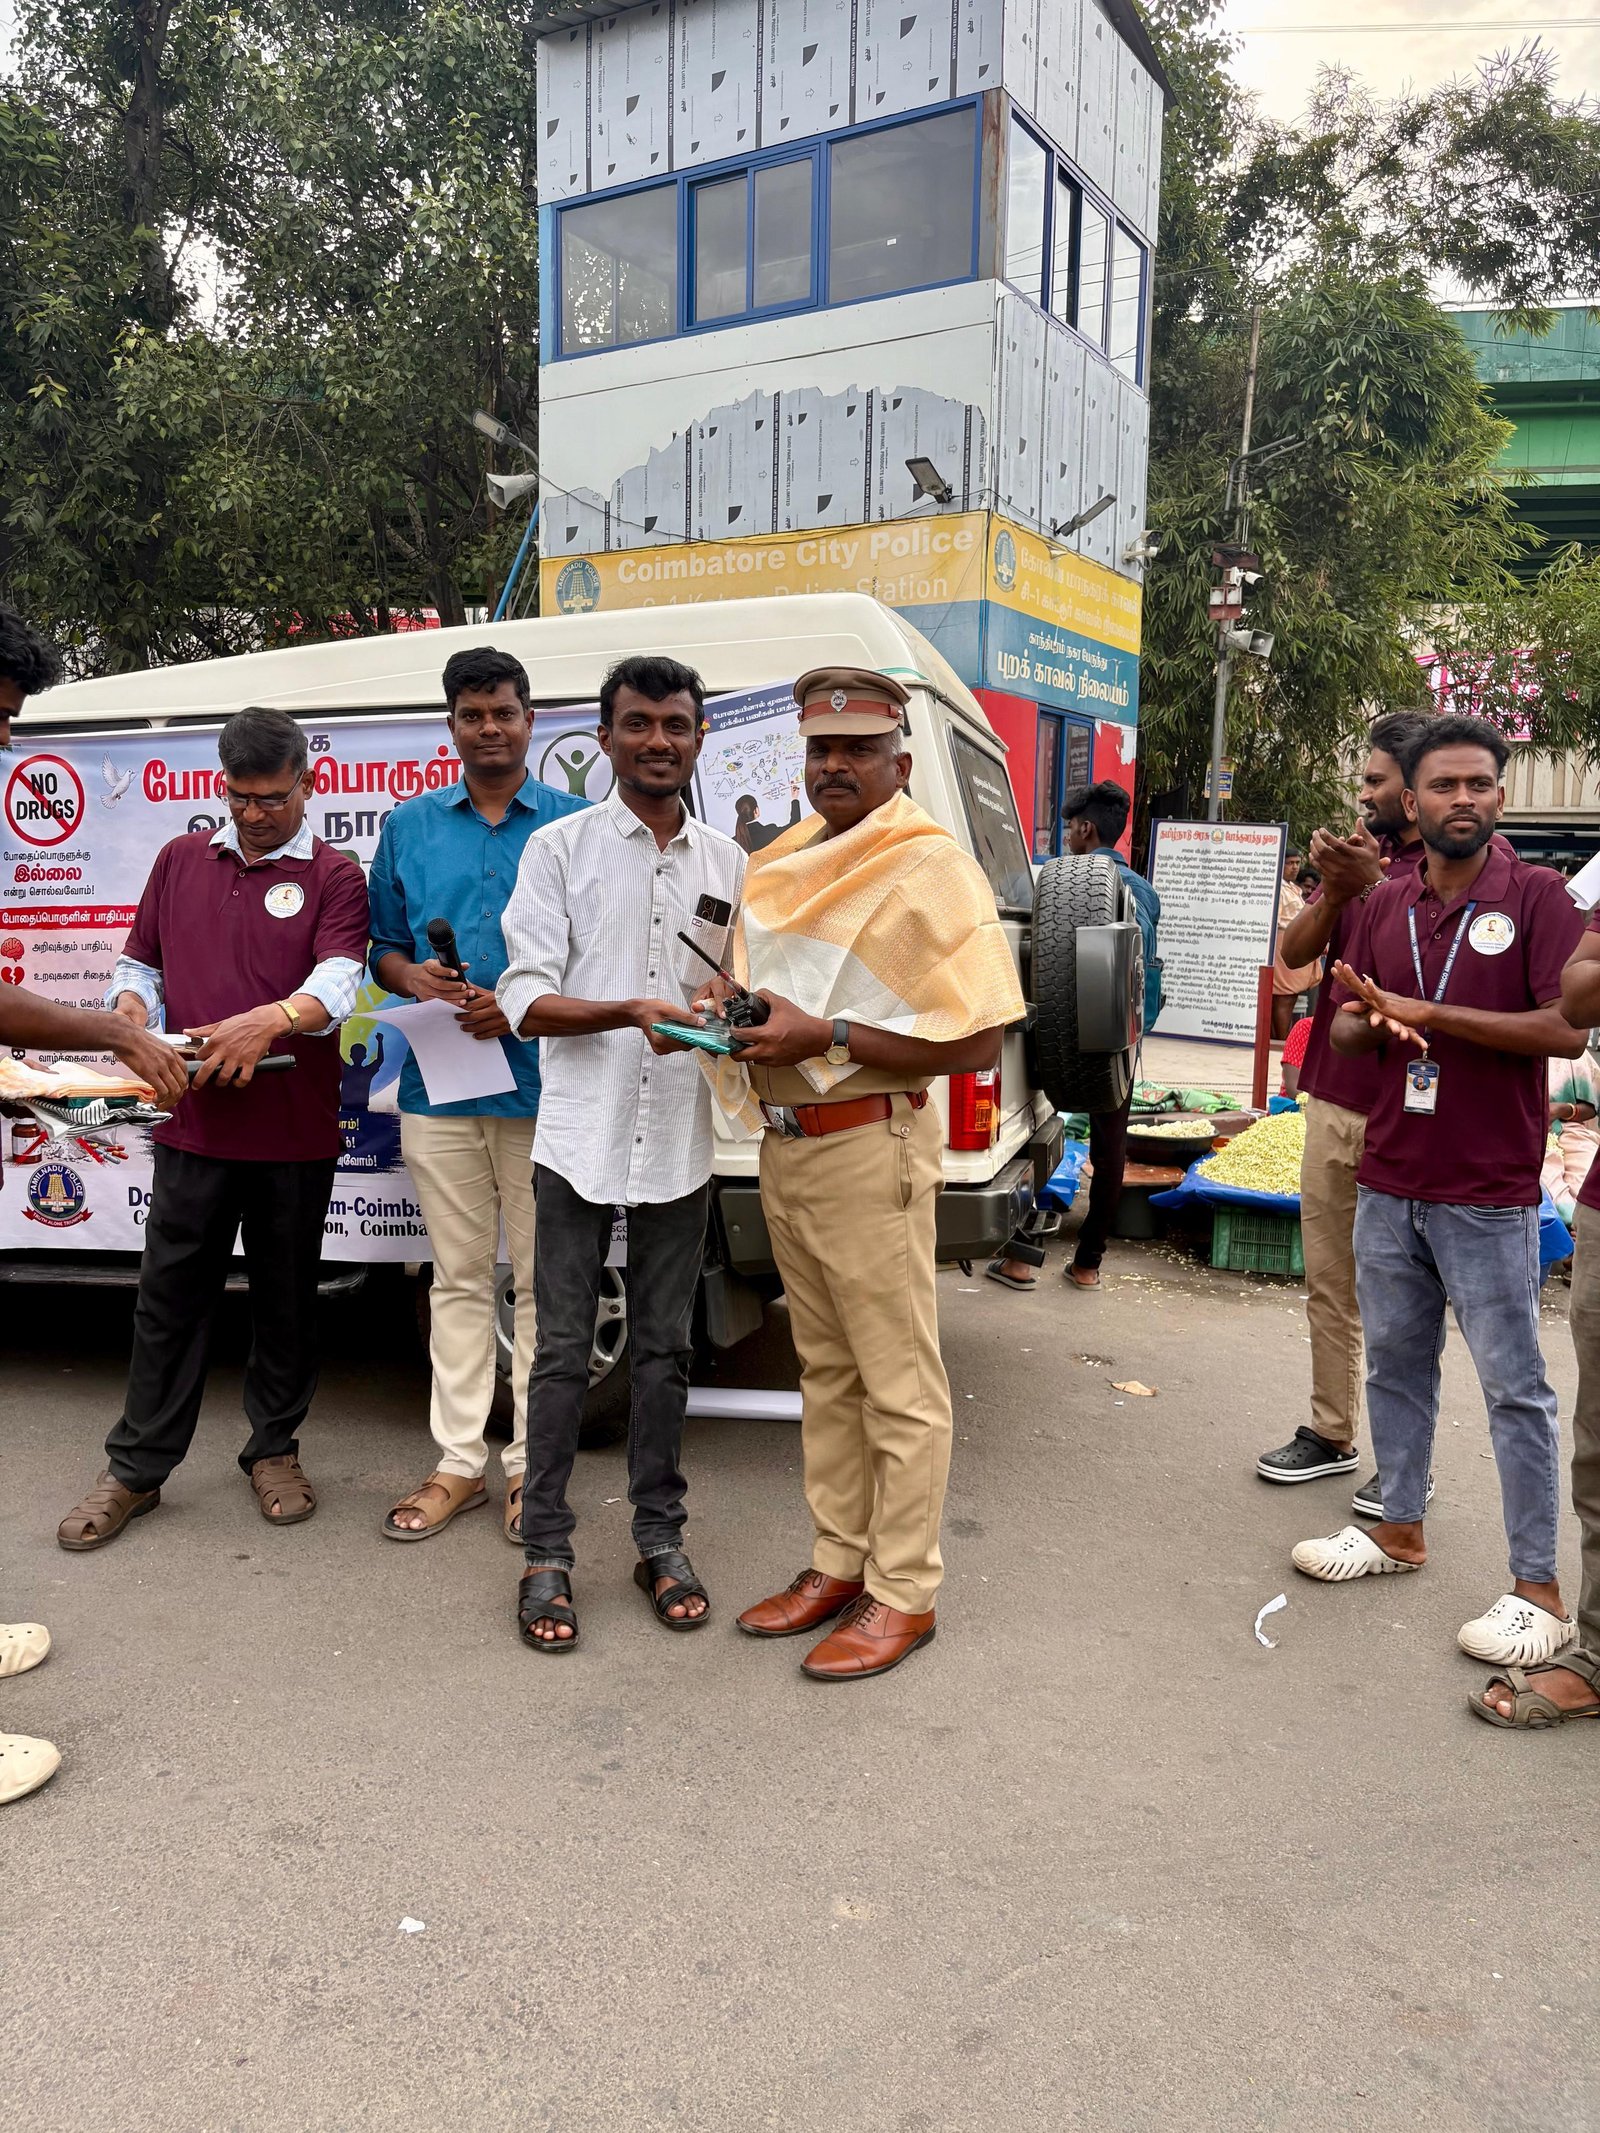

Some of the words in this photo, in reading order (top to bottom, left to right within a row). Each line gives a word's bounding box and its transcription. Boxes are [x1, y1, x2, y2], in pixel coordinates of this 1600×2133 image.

[618, 548, 785, 584] Coimbatore
[797, 538, 858, 571] City
[870, 525, 974, 560] Police
[558, 562, 583, 590] TAMILNADU
[584, 563, 600, 588] POLICE
[857, 575, 948, 602] Station
[997, 648, 1031, 681] புறக்
[1034, 664, 1076, 692] காவல்
[1077, 669, 1130, 707] நிலையம்
[30, 772, 58, 795] NO
[16, 799, 75, 820] DRUGS
[1160, 828, 1192, 841] தமிழ்நாடு
[1193, 830, 1210, 841] அரசு
[1225, 830, 1261, 845] போக்குவரத்து
[1262, 834, 1278, 846] துறை
[3, 850, 91, 862] போதைப்பொருளுக்கு
[14, 863, 82, 883] இல்லை
[3, 886, 27, 899] என்று
[2, 910, 91, 926] போதைப்பொருளின்
[32, 941, 78, 954] அறிவுக்கும்
[81, 940, 112, 953] பாதிப்பு
[34, 972, 80, 982] உறவுகளை
[83, 970, 115, 982] சிதைக்
[1438, 972, 1449, 990] BOSCO
[80, 998, 106, 1010] கெடுக்
[31, 1165, 64, 1195] TAMILNADU
[65, 1169, 83, 1197] POLICE
[129, 1187, 152, 1206] Do
[328, 1197, 423, 1217] m-Coimba
[360, 1220, 428, 1236] Coimba
